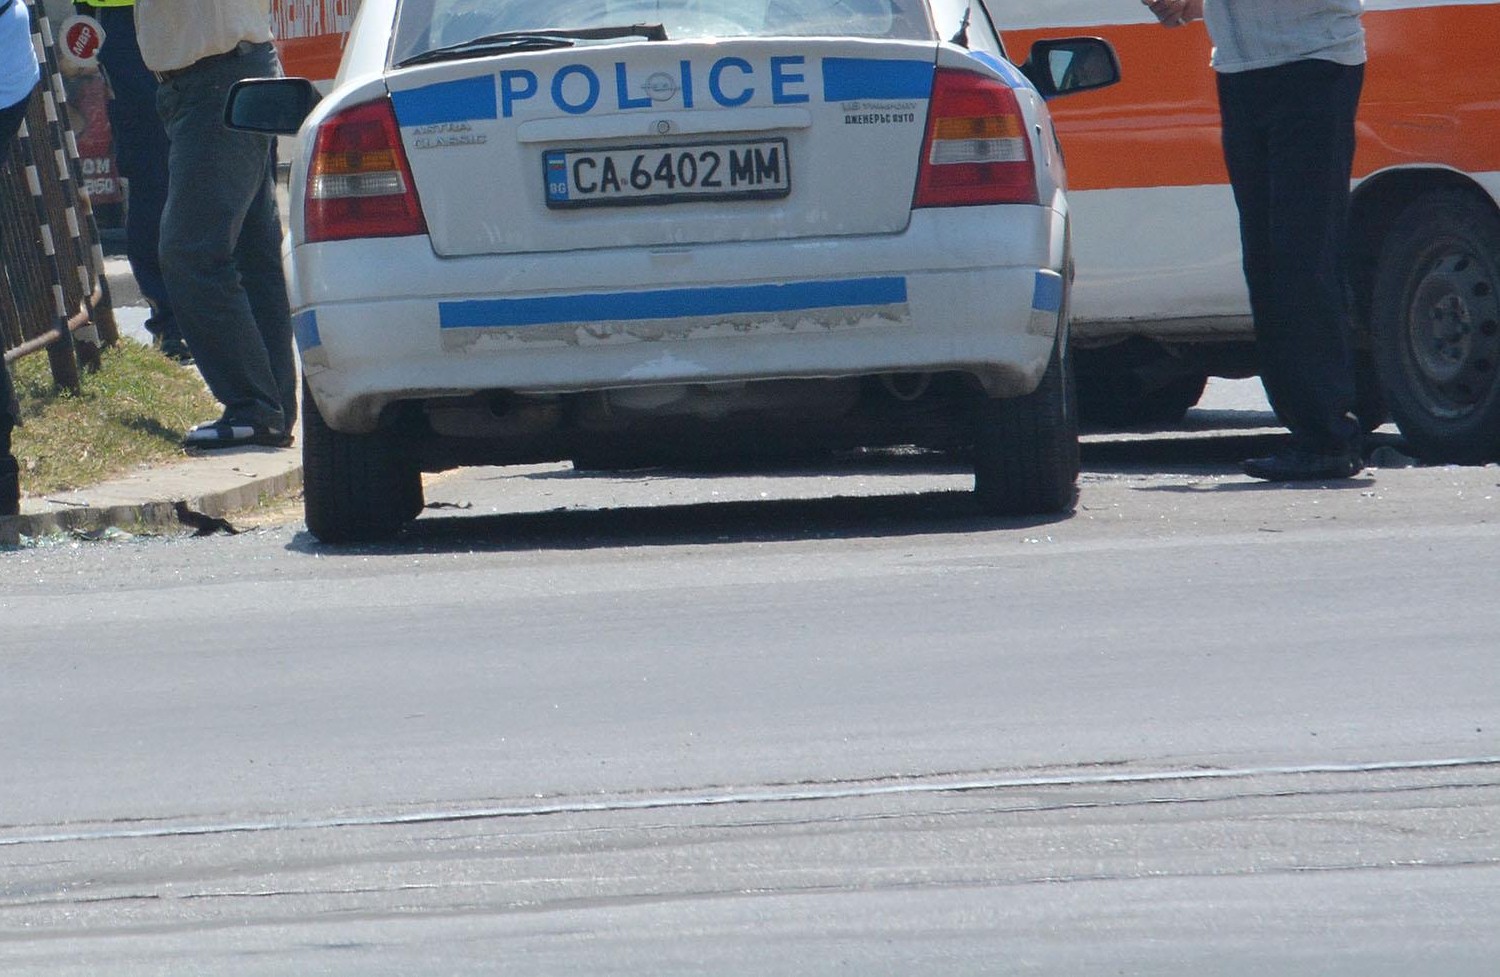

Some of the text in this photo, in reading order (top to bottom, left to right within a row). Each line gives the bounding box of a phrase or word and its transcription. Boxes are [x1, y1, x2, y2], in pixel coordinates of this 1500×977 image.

[500, 56, 809, 118] POLICE
[573, 147, 781, 194] CA 6402 MM
